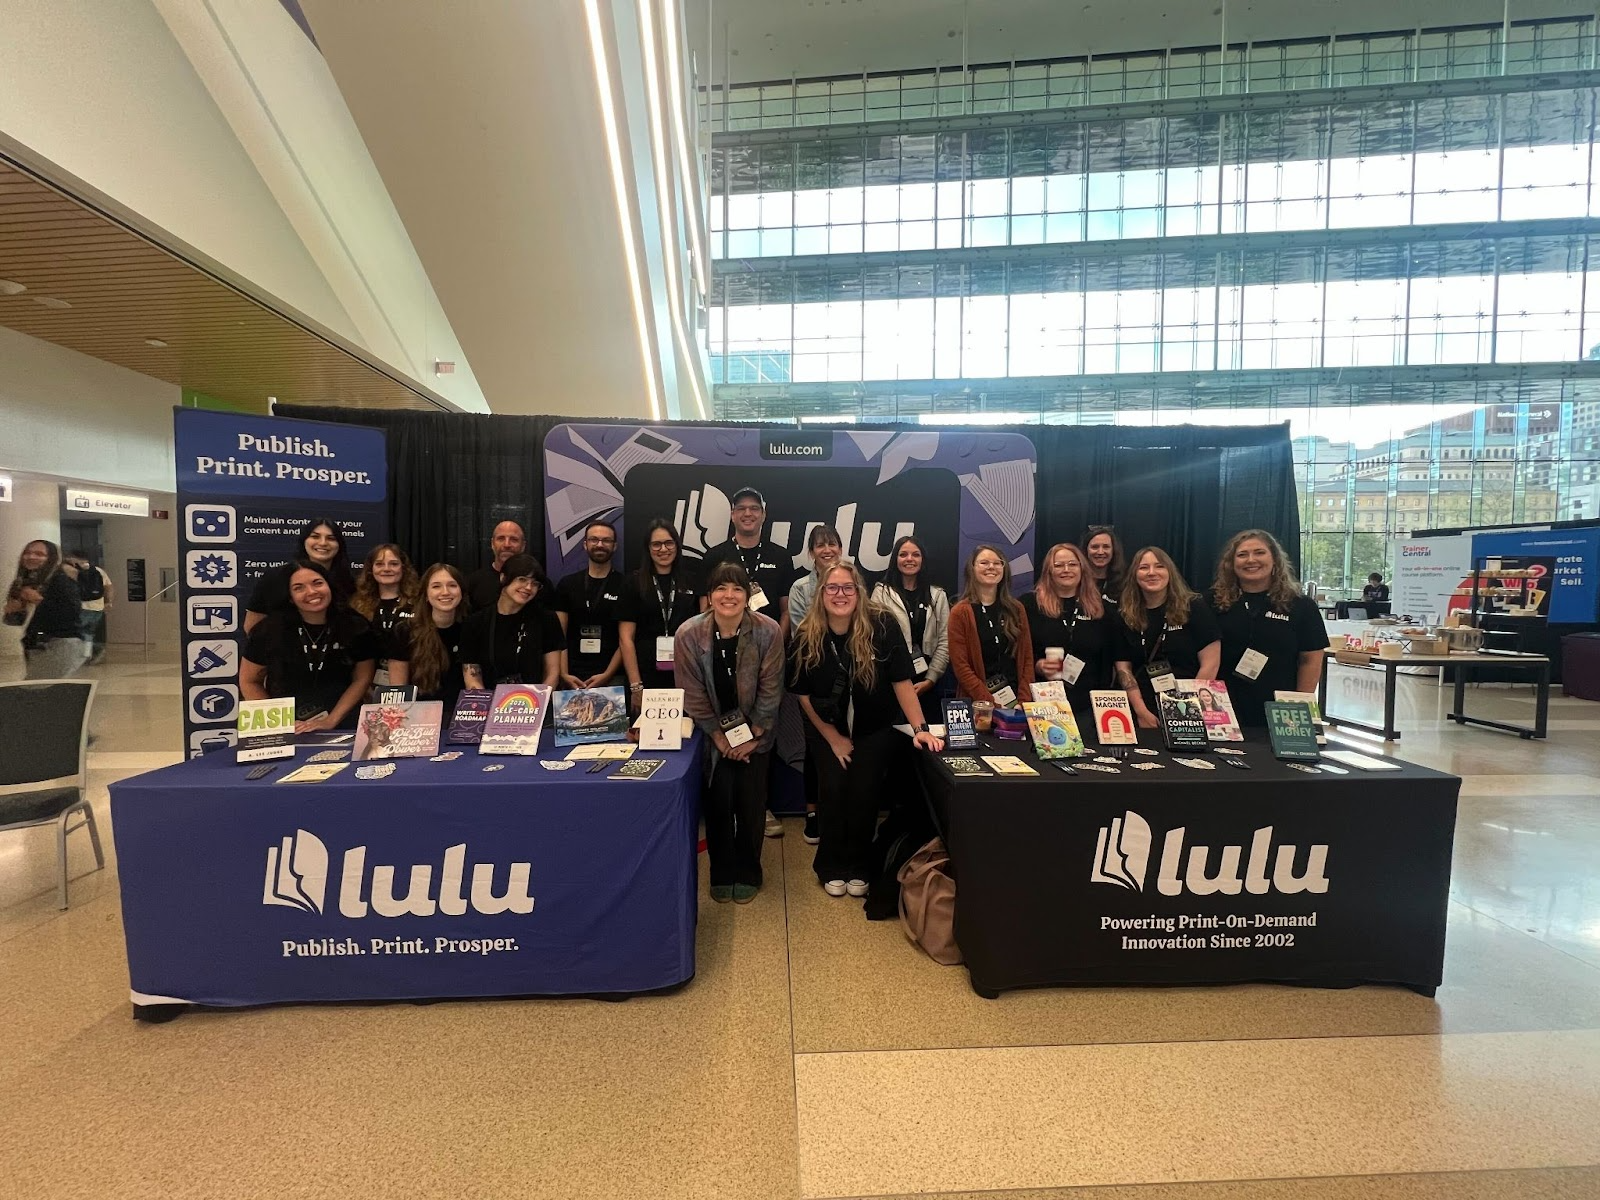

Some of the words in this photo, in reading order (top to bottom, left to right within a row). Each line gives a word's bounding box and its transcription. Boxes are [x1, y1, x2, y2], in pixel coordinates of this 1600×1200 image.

[238, 433, 336, 458] Publish.
[769, 442, 823, 456] lulu.com
[196, 456, 271, 478] Print.
[276, 462, 371, 486] Prosper.
[95, 499, 131, 509] Elevator
[244, 515, 285, 525] Maintain
[243, 527, 281, 535] content
[244, 560, 268, 568] Zero
[1560, 578, 1584, 586] Sell.
[380, 691, 406, 705] VISUAL
[494, 706, 541, 715] SELF-CARE
[645, 707, 680, 720] CEO
[946, 708, 971, 724] EPIC
[1271, 709, 1310, 725] FREE
[238, 706, 295, 732] CASH
[493, 715, 537, 724] PLANNER
[948, 722, 972, 731] CONTENT
[1274, 726, 1311, 737] MONEY
[1157, 826, 1329, 896] lulu
[339, 843, 535, 918] lulu
[1100, 914, 1175, 932] Powering
[1178, 912, 1318, 929] Print-On-Demand
[282, 938, 366, 957] Publish.
[370, 936, 430, 955] Print.
[434, 936, 520, 956] Prosper.
[1121, 933, 1206, 950] Innovation
[1210, 933, 1251, 948] Since
[1254, 933, 1295, 947] 2002
